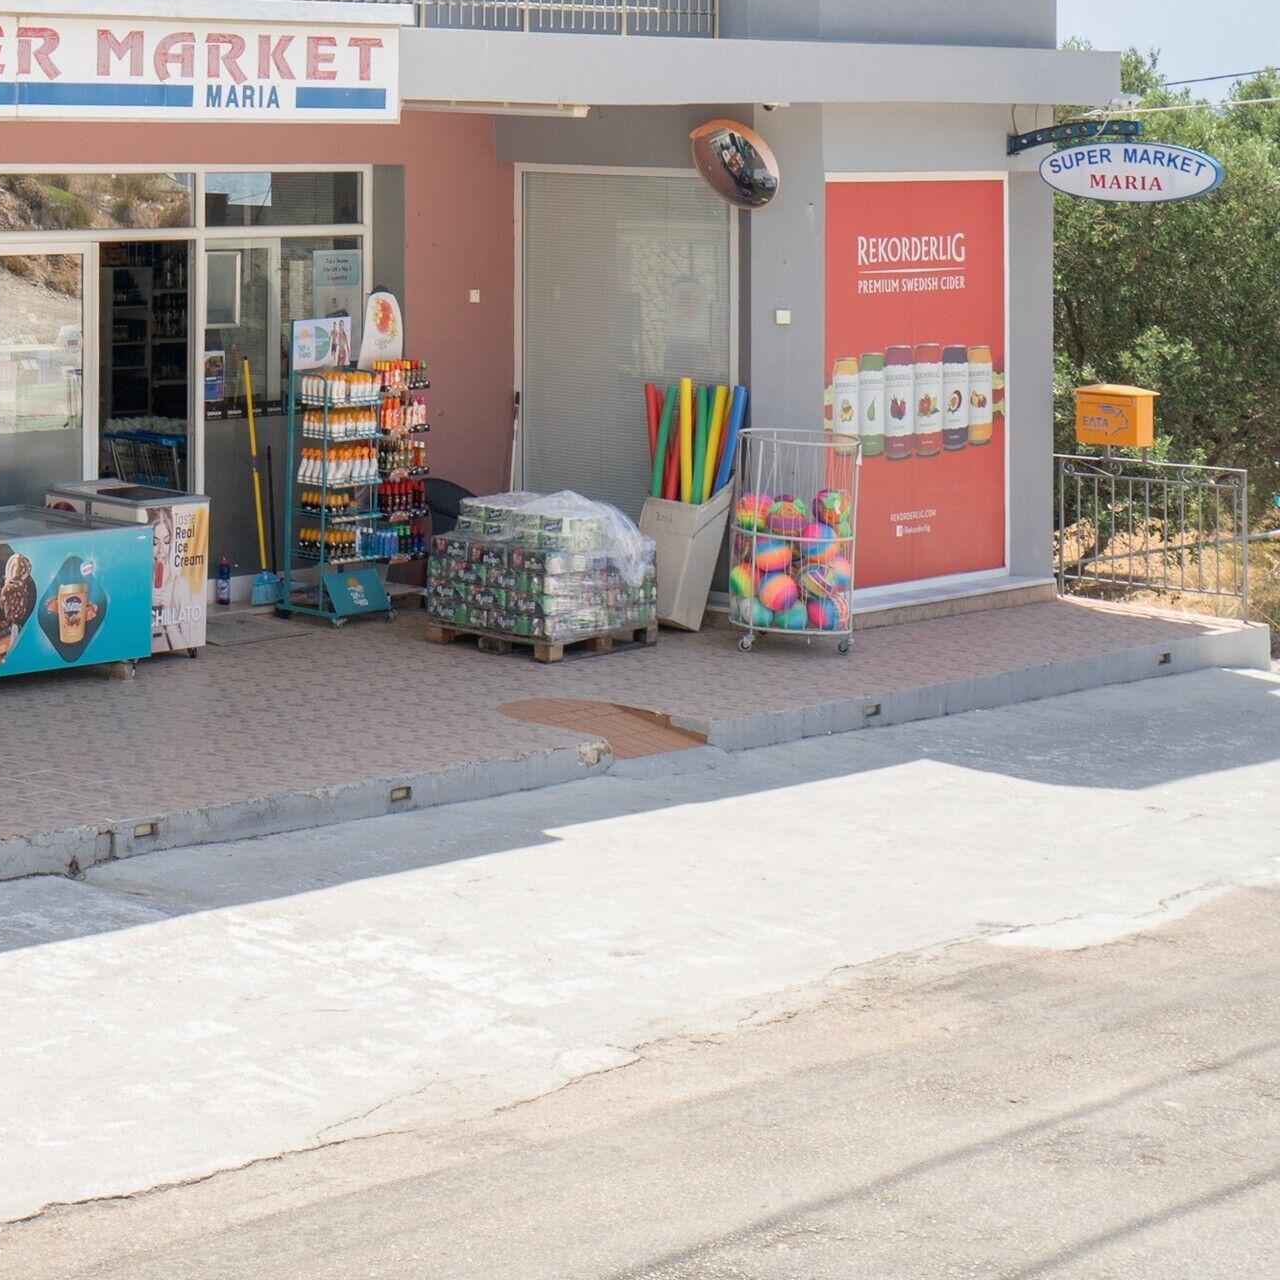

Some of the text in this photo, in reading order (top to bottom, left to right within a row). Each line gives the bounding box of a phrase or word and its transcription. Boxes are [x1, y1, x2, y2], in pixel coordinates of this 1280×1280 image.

[96, 28, 384, 85] MARKET
[206, 84, 280, 108] MARIA
[1049, 147, 1206, 177] SUPER MARKET
[1089, 173, 1163, 191] MARIA
[857, 233, 965, 265] REKORDERLIG
[858, 276, 965, 294] PREMIUM SWEDISH CIDER
[174, 513, 197, 526] Taste
[175, 526, 195, 539] Real
[174, 541, 188, 553] Ice
[174, 553, 204, 567] Cream
